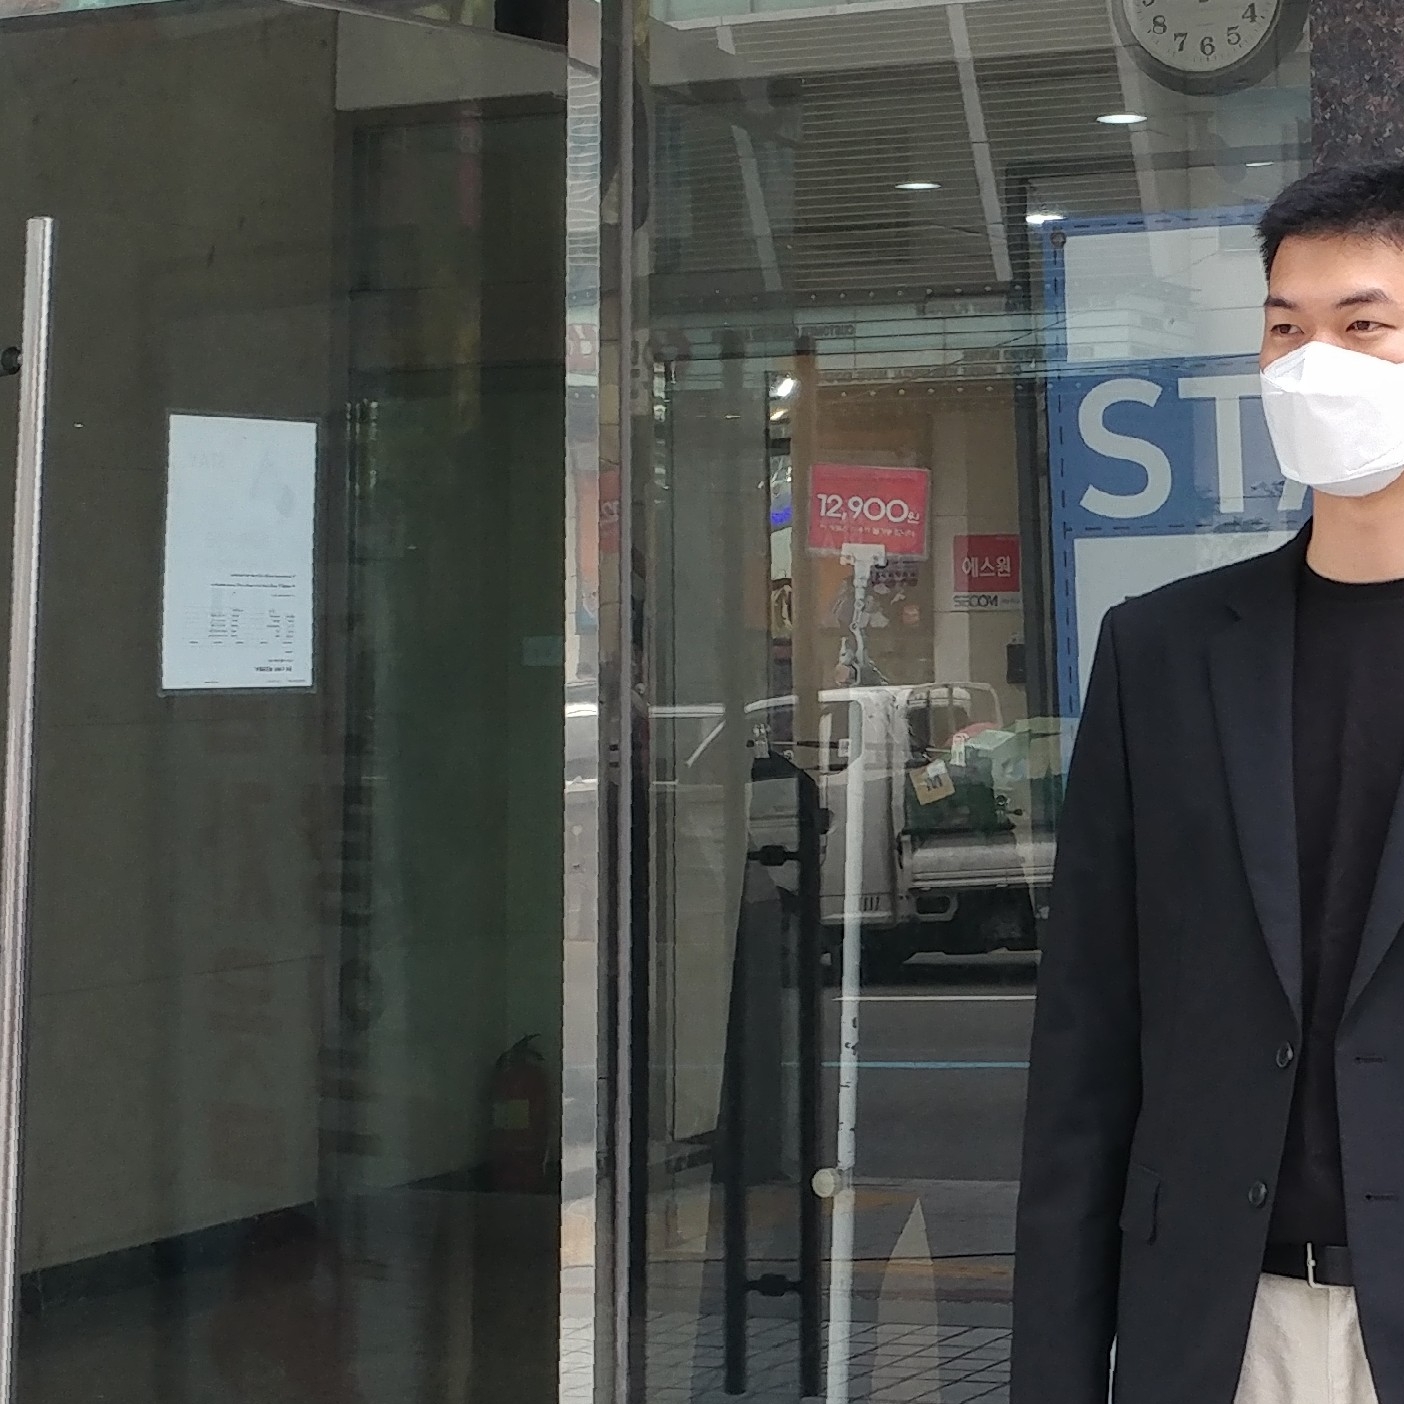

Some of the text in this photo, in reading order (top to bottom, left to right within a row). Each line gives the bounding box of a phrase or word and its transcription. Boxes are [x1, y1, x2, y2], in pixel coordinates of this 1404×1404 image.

[1241, 3, 1258, 23] 4
[1152, 15, 1168, 35] 8
[1173, 32, 1188, 52] 7
[1226, 25, 1242, 46] 5
[1200, 36, 1216, 56] 6
[1078, 373, 1309, 519] ST
[816, 493, 920, 524] 12,900원
[961, 555, 1012, 578] 에스원
[953, 594, 999, 608] SECOM
